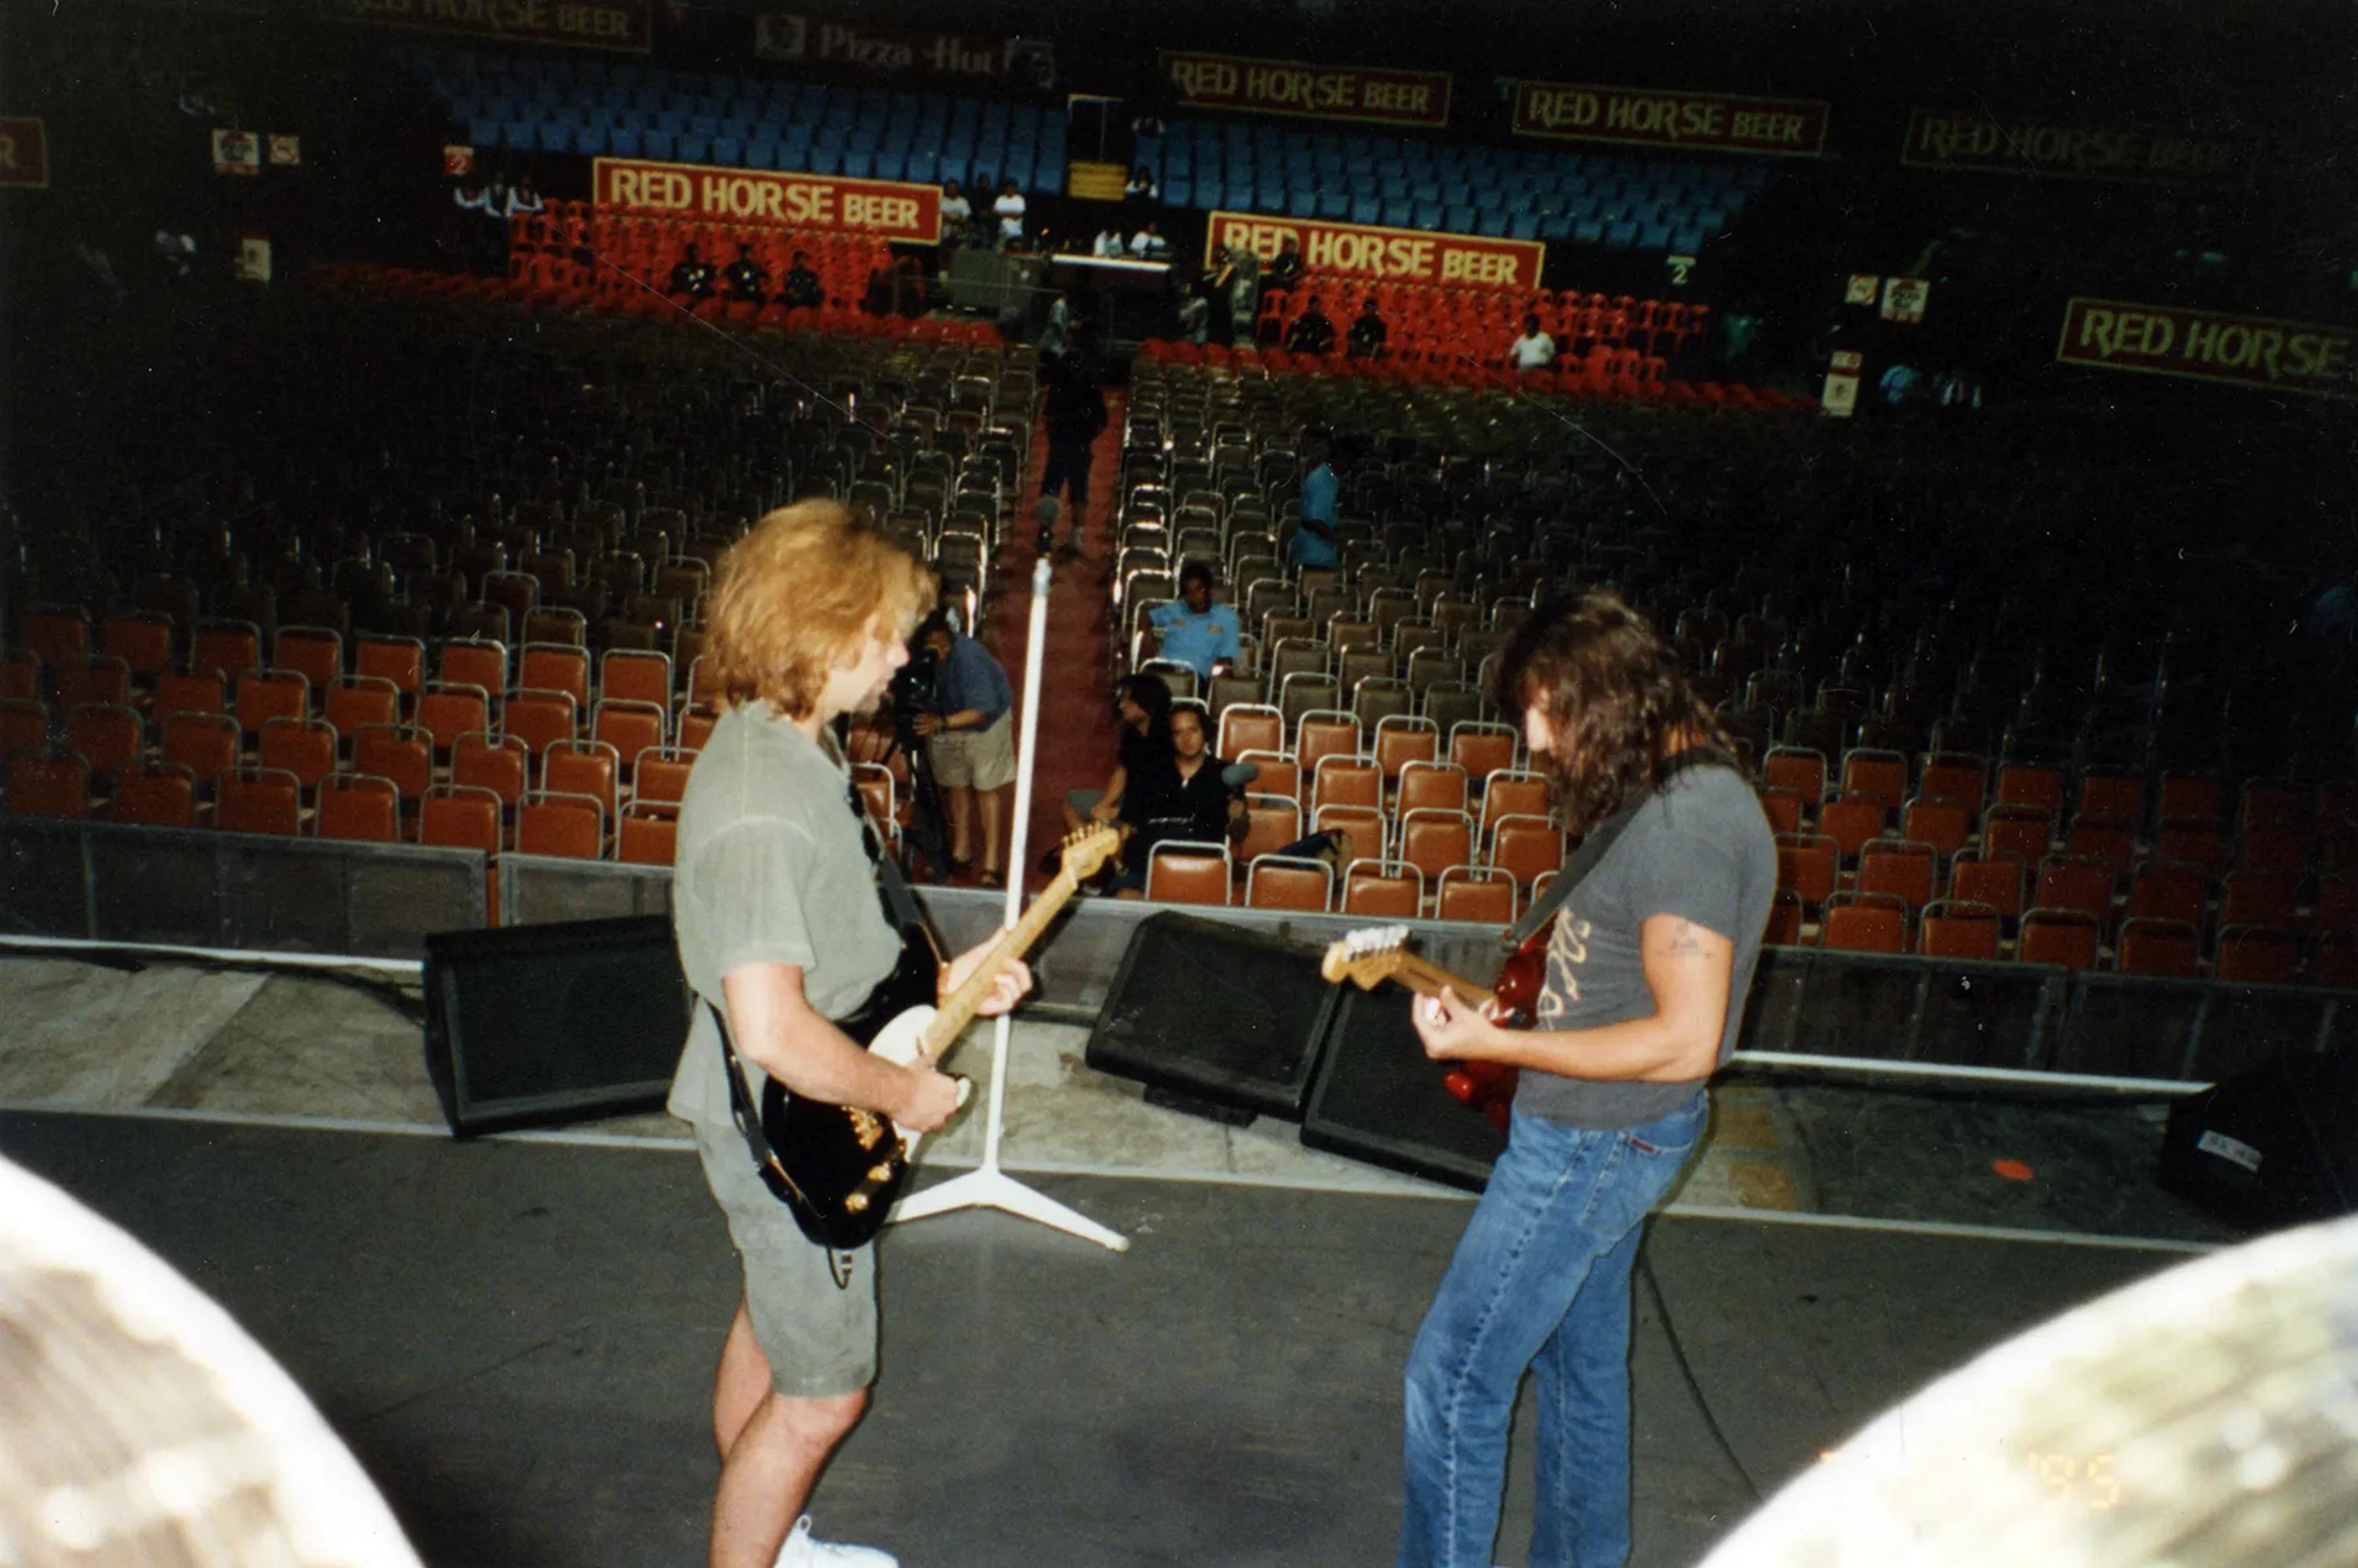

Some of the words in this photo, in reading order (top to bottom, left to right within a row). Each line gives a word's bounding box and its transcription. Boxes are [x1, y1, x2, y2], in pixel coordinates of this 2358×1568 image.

[557, 7, 631, 37] BEER
[820, 23, 912, 67] Pizza
[1172, 60, 1238, 99] RED
[1247, 68, 1356, 111] HORSE
[1361, 81, 1430, 112] BEER
[1530, 90, 1600, 128] RED
[1606, 96, 1726, 141] HORSE
[1730, 111, 1804, 142] BEER
[1920, 117, 1998, 158] RED
[610, 167, 693, 209] RED
[701, 176, 835, 223] HORSE
[842, 193, 920, 230] BEER
[1307, 230, 1437, 278] HORSE
[1442, 247, 1519, 285] BEER
[1671, 263, 1689, 285] 2
[2079, 308, 2176, 358] RED
[2183, 319, 2351, 381] HORSE
